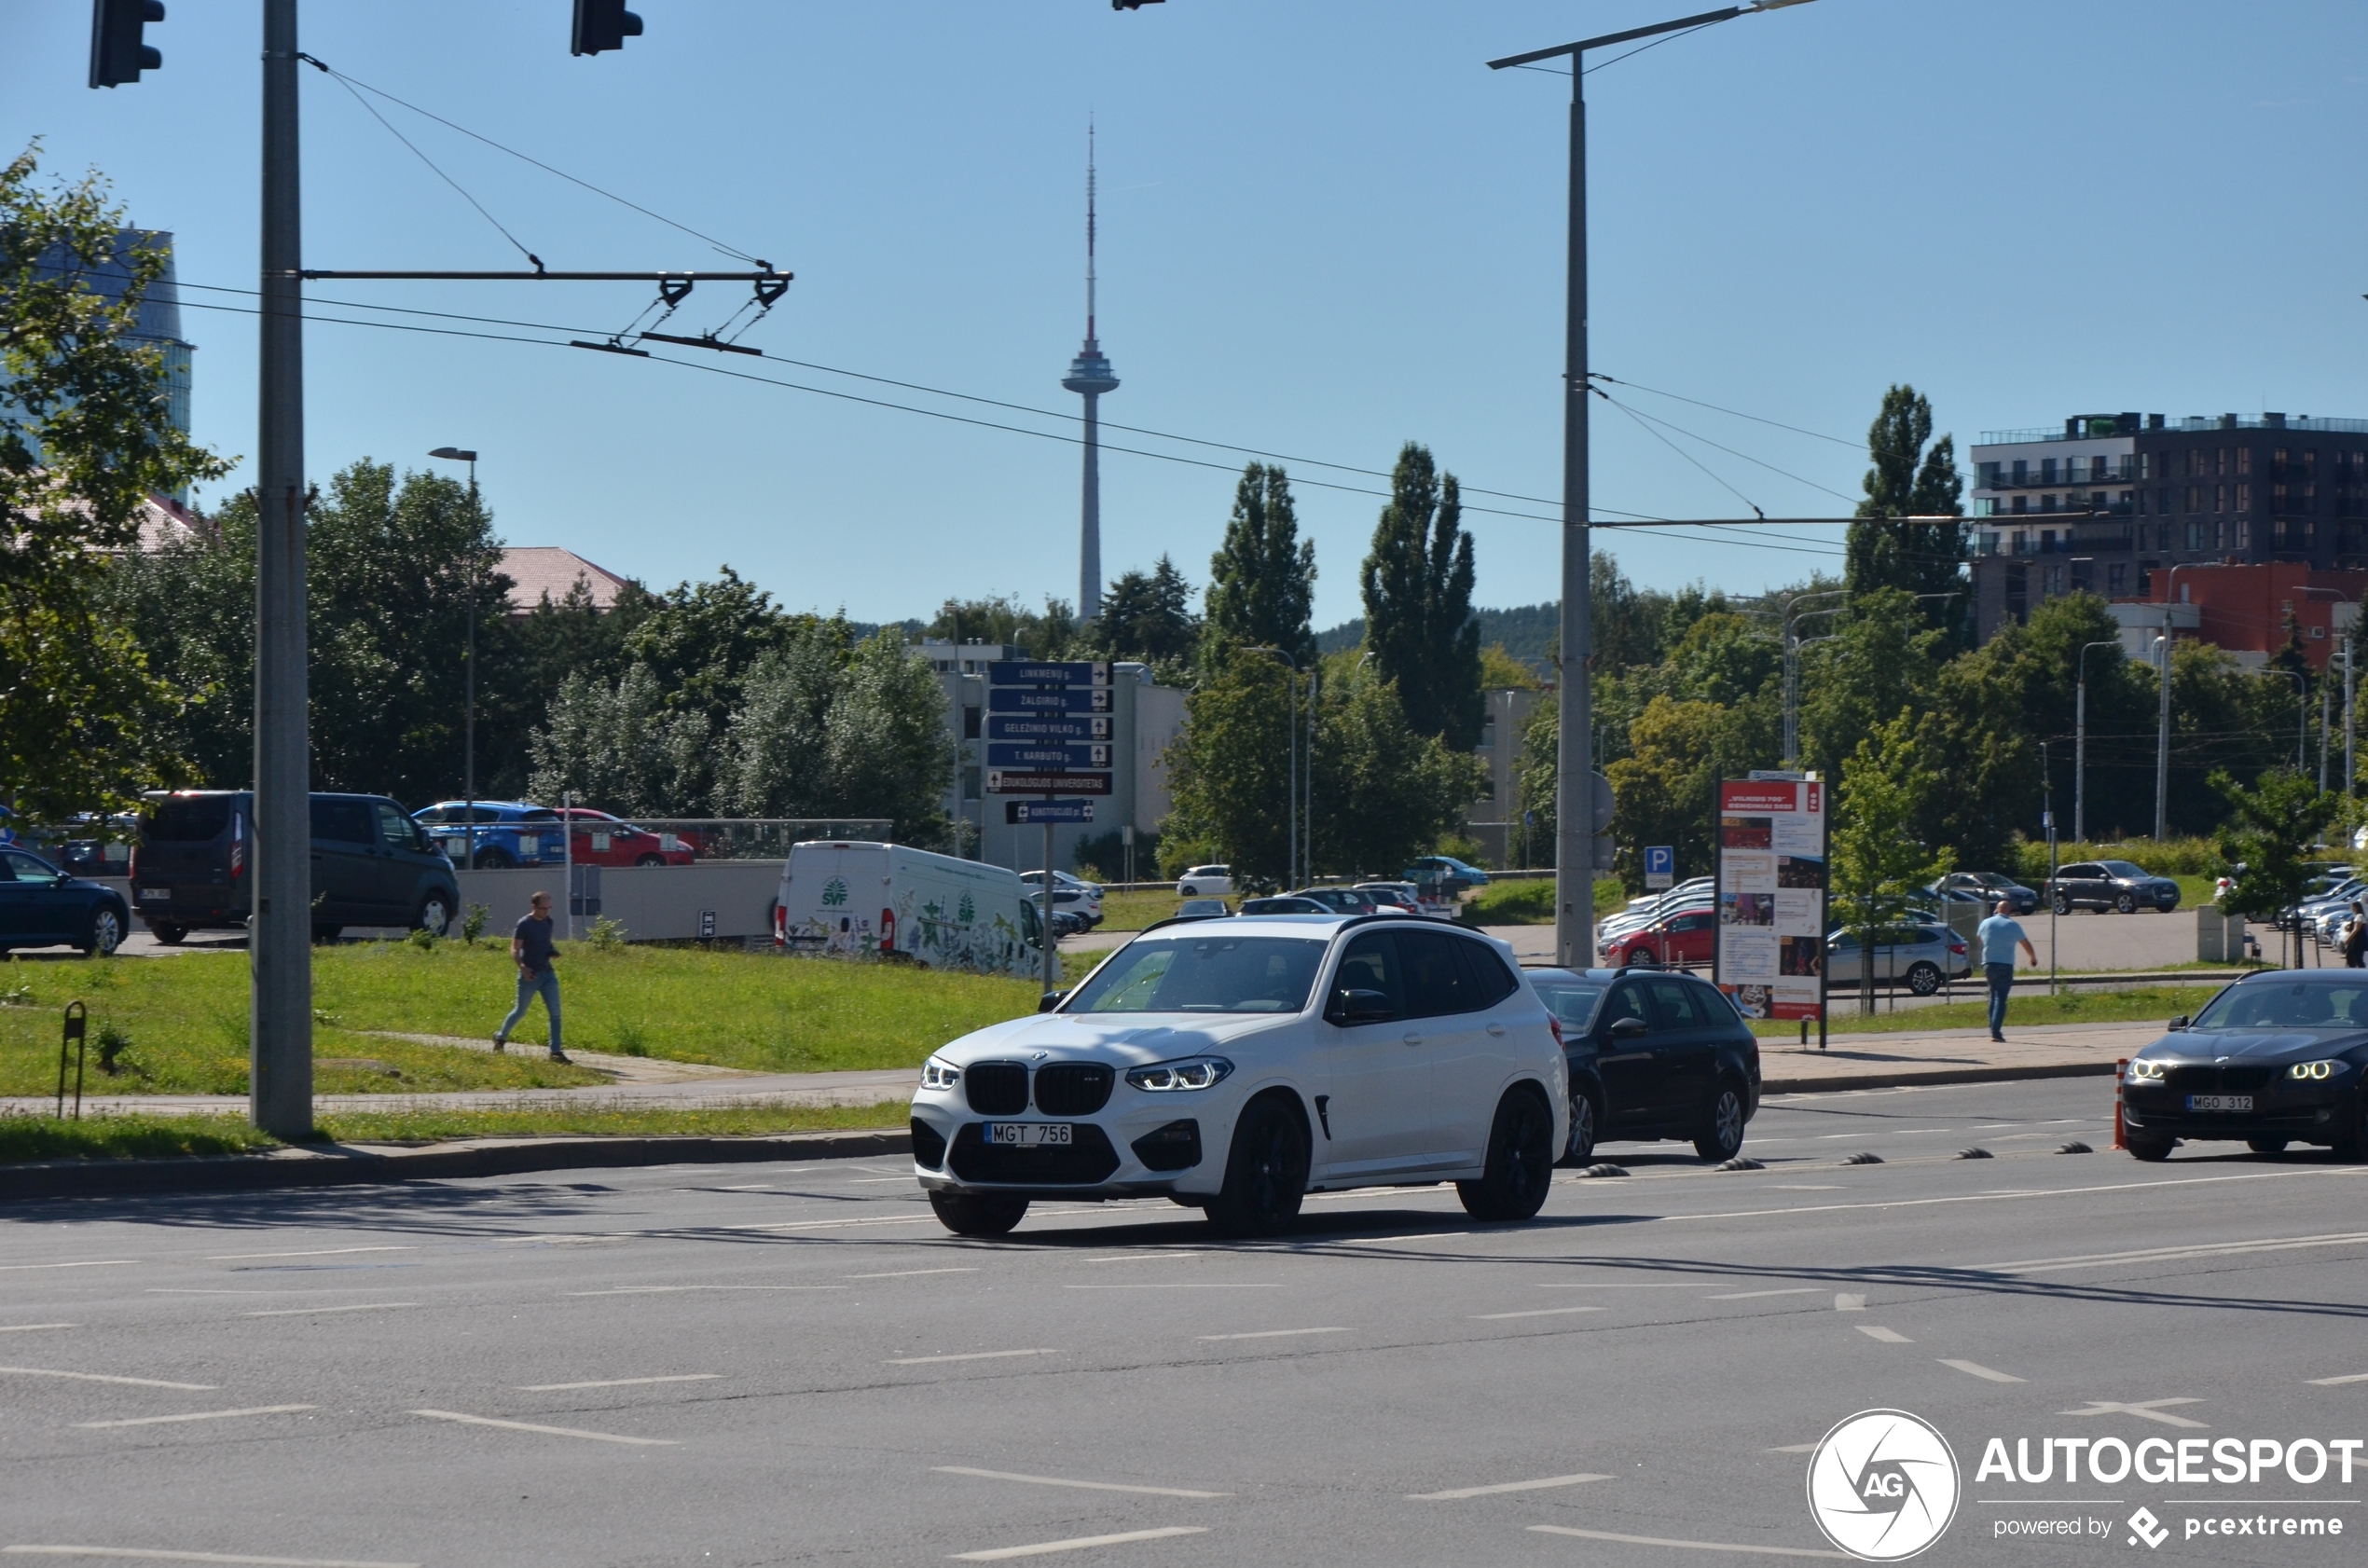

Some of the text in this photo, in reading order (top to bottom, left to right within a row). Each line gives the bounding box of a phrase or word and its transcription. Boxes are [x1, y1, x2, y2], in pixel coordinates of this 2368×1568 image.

[1020, 669, 1072, 681] LINKMENŲ g.
[1020, 695, 1069, 708] ŽALGIRIO g.
[1005, 722, 1083, 736] GELEŽINIO VILKO g.
[1014, 751, 1072, 763] T. NARBUTO g.
[1003, 777, 1104, 789] EDUKOLOGIJOS UNIVERSITETAS
[1031, 807, 1073, 817] KONSTITUCIJOS
[1653, 850, 1667, 871] P
[822, 891, 848, 906] SVF
[958, 908, 975, 923] SVF
[2194, 1096, 2220, 1107] MGO
[2228, 1097, 2251, 1108] 312
[994, 1125, 1027, 1142] MGT
[1039, 1126, 1068, 1142] 756
